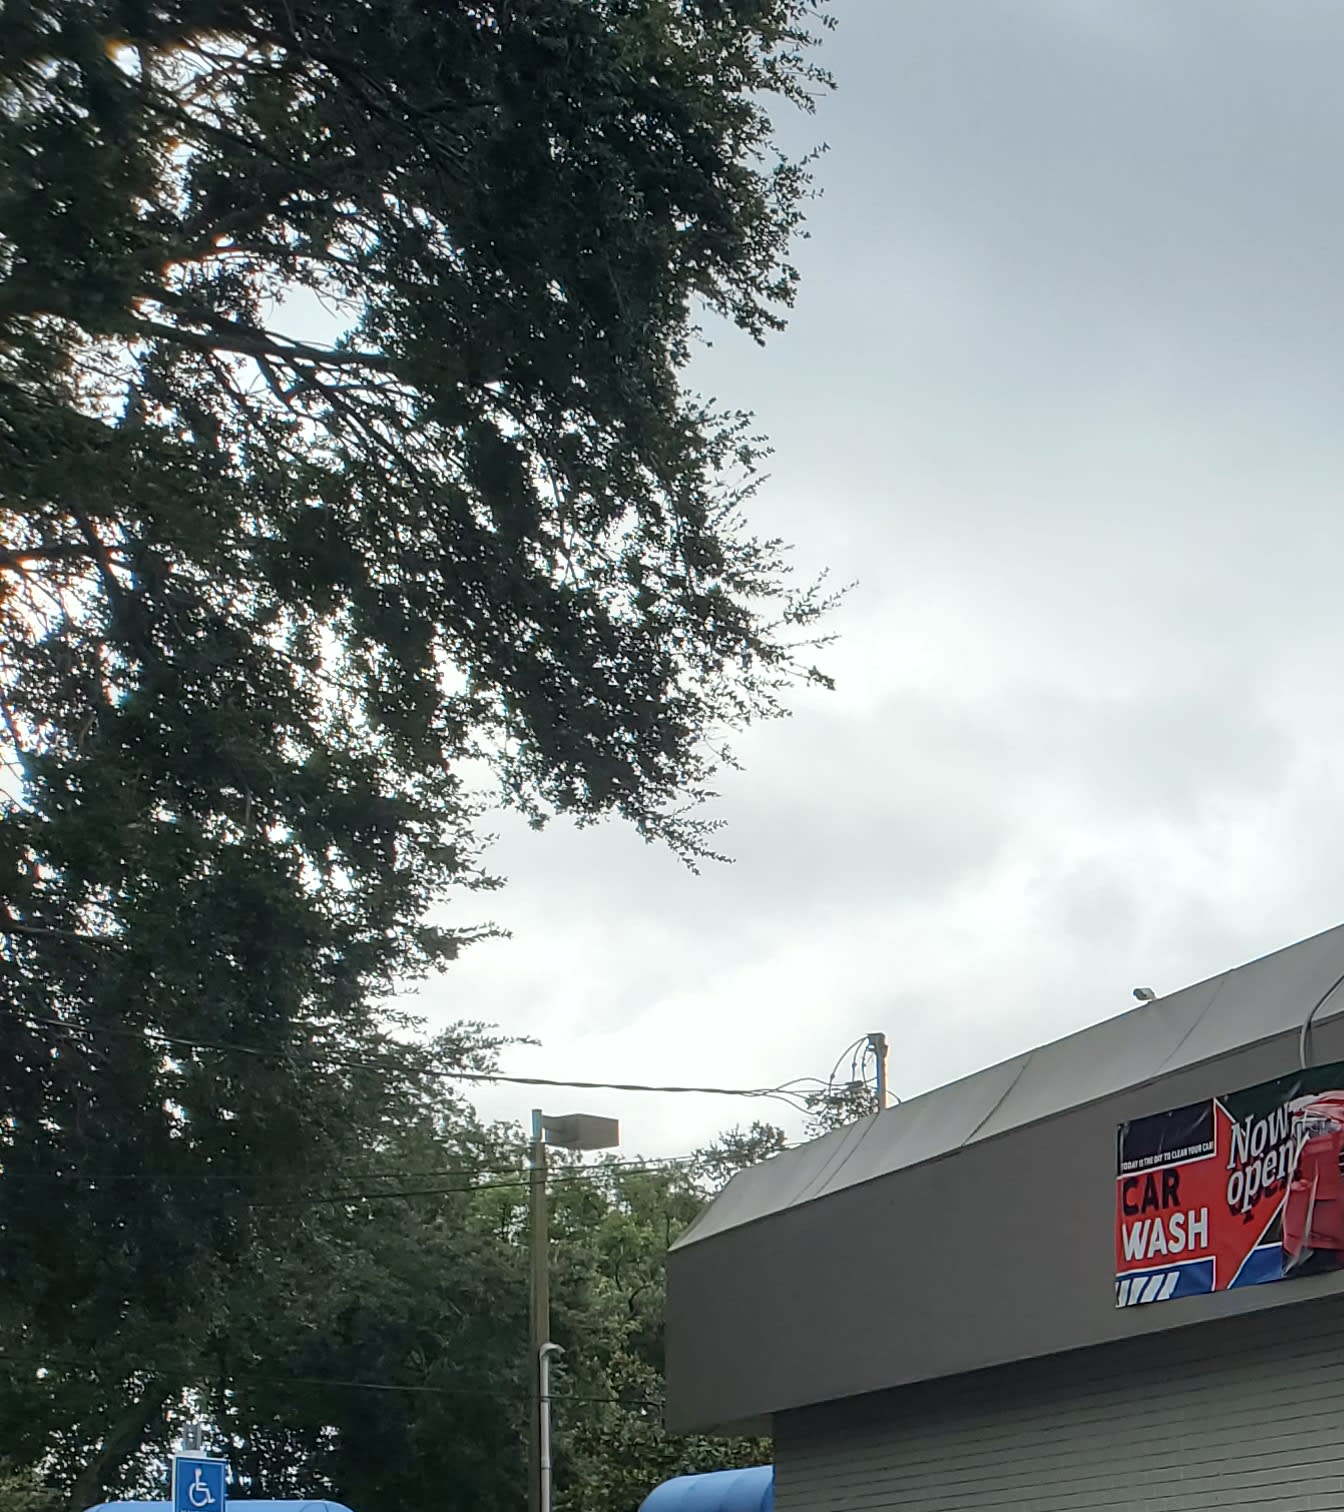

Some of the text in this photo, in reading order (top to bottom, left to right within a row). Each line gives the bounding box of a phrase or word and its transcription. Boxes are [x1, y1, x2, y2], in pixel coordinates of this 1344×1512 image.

[1226, 1102, 1291, 1170] Now
[1122, 1168, 1180, 1216] CAR
[1121, 1208, 1208, 1262] WASH
